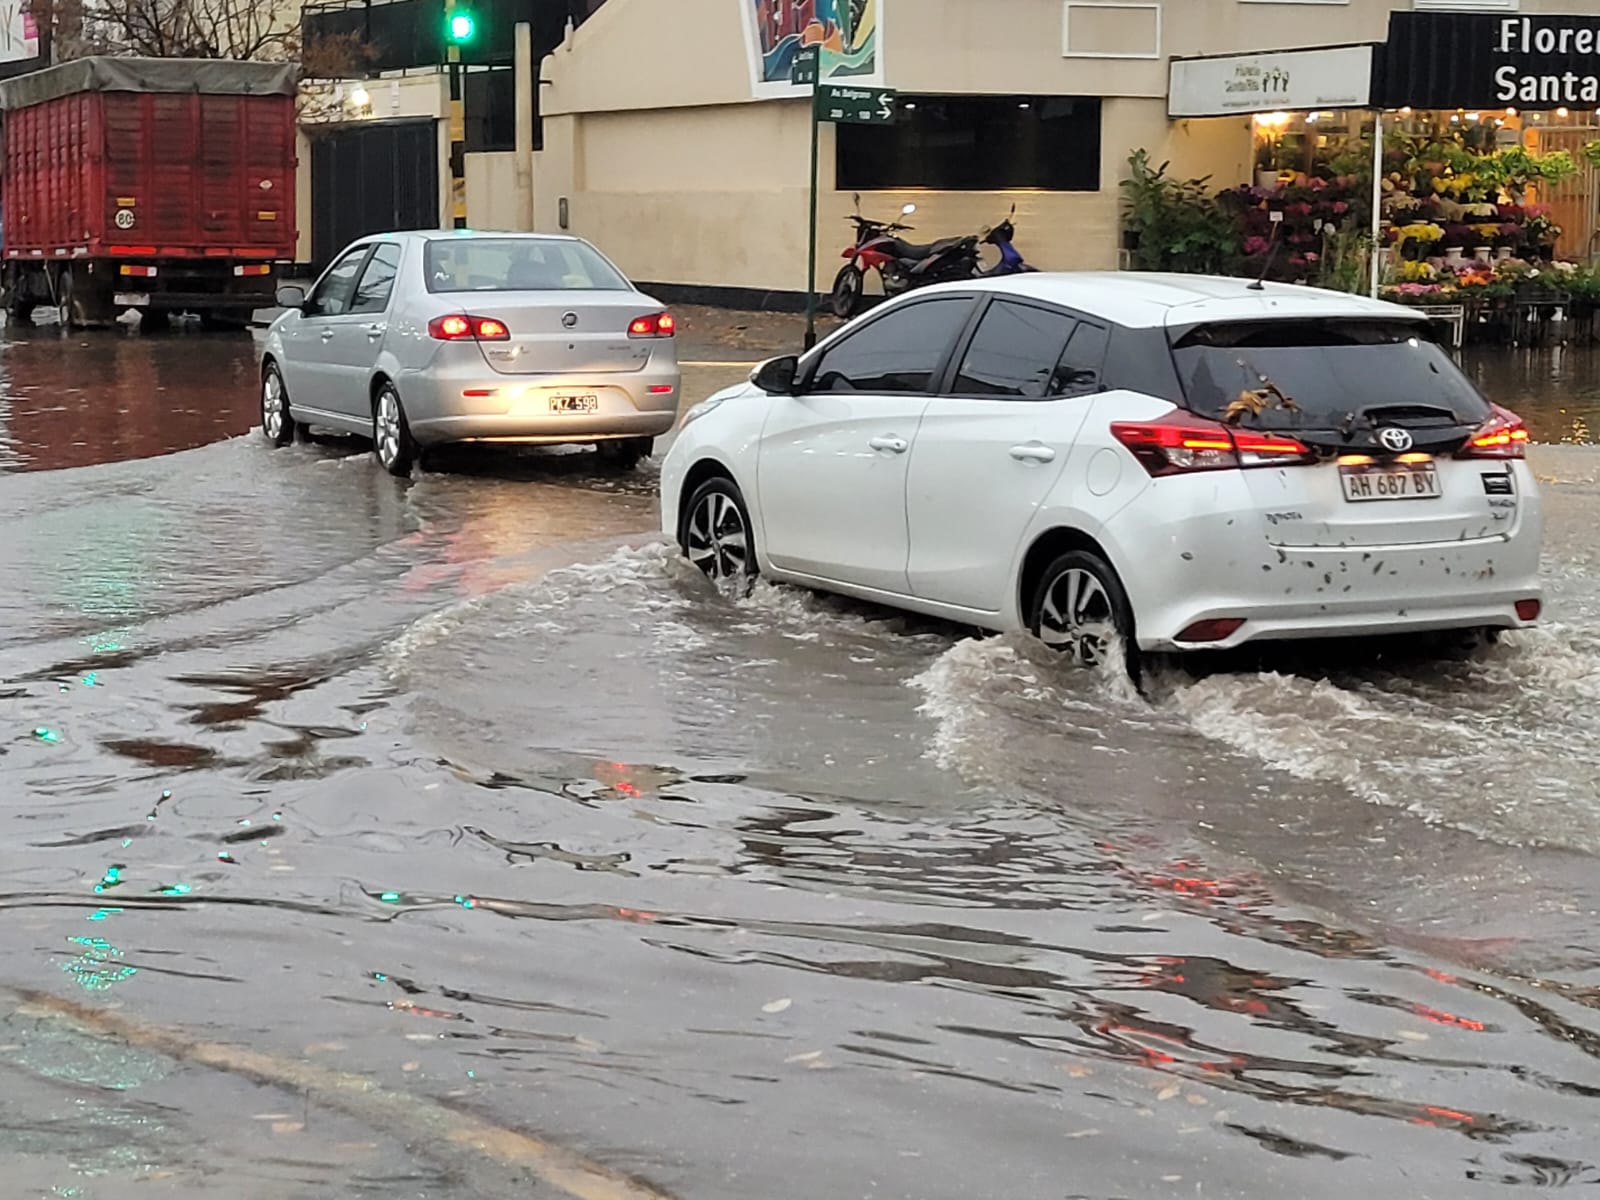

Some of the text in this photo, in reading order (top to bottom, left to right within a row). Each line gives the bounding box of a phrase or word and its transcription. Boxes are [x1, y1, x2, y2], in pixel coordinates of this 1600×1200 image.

[1501, 17, 1600, 54] Flore
[1494, 65, 1598, 101] Santa
[550, 397, 571, 411] PKZ
[1350, 472, 1434, 497] AH 687 BY
